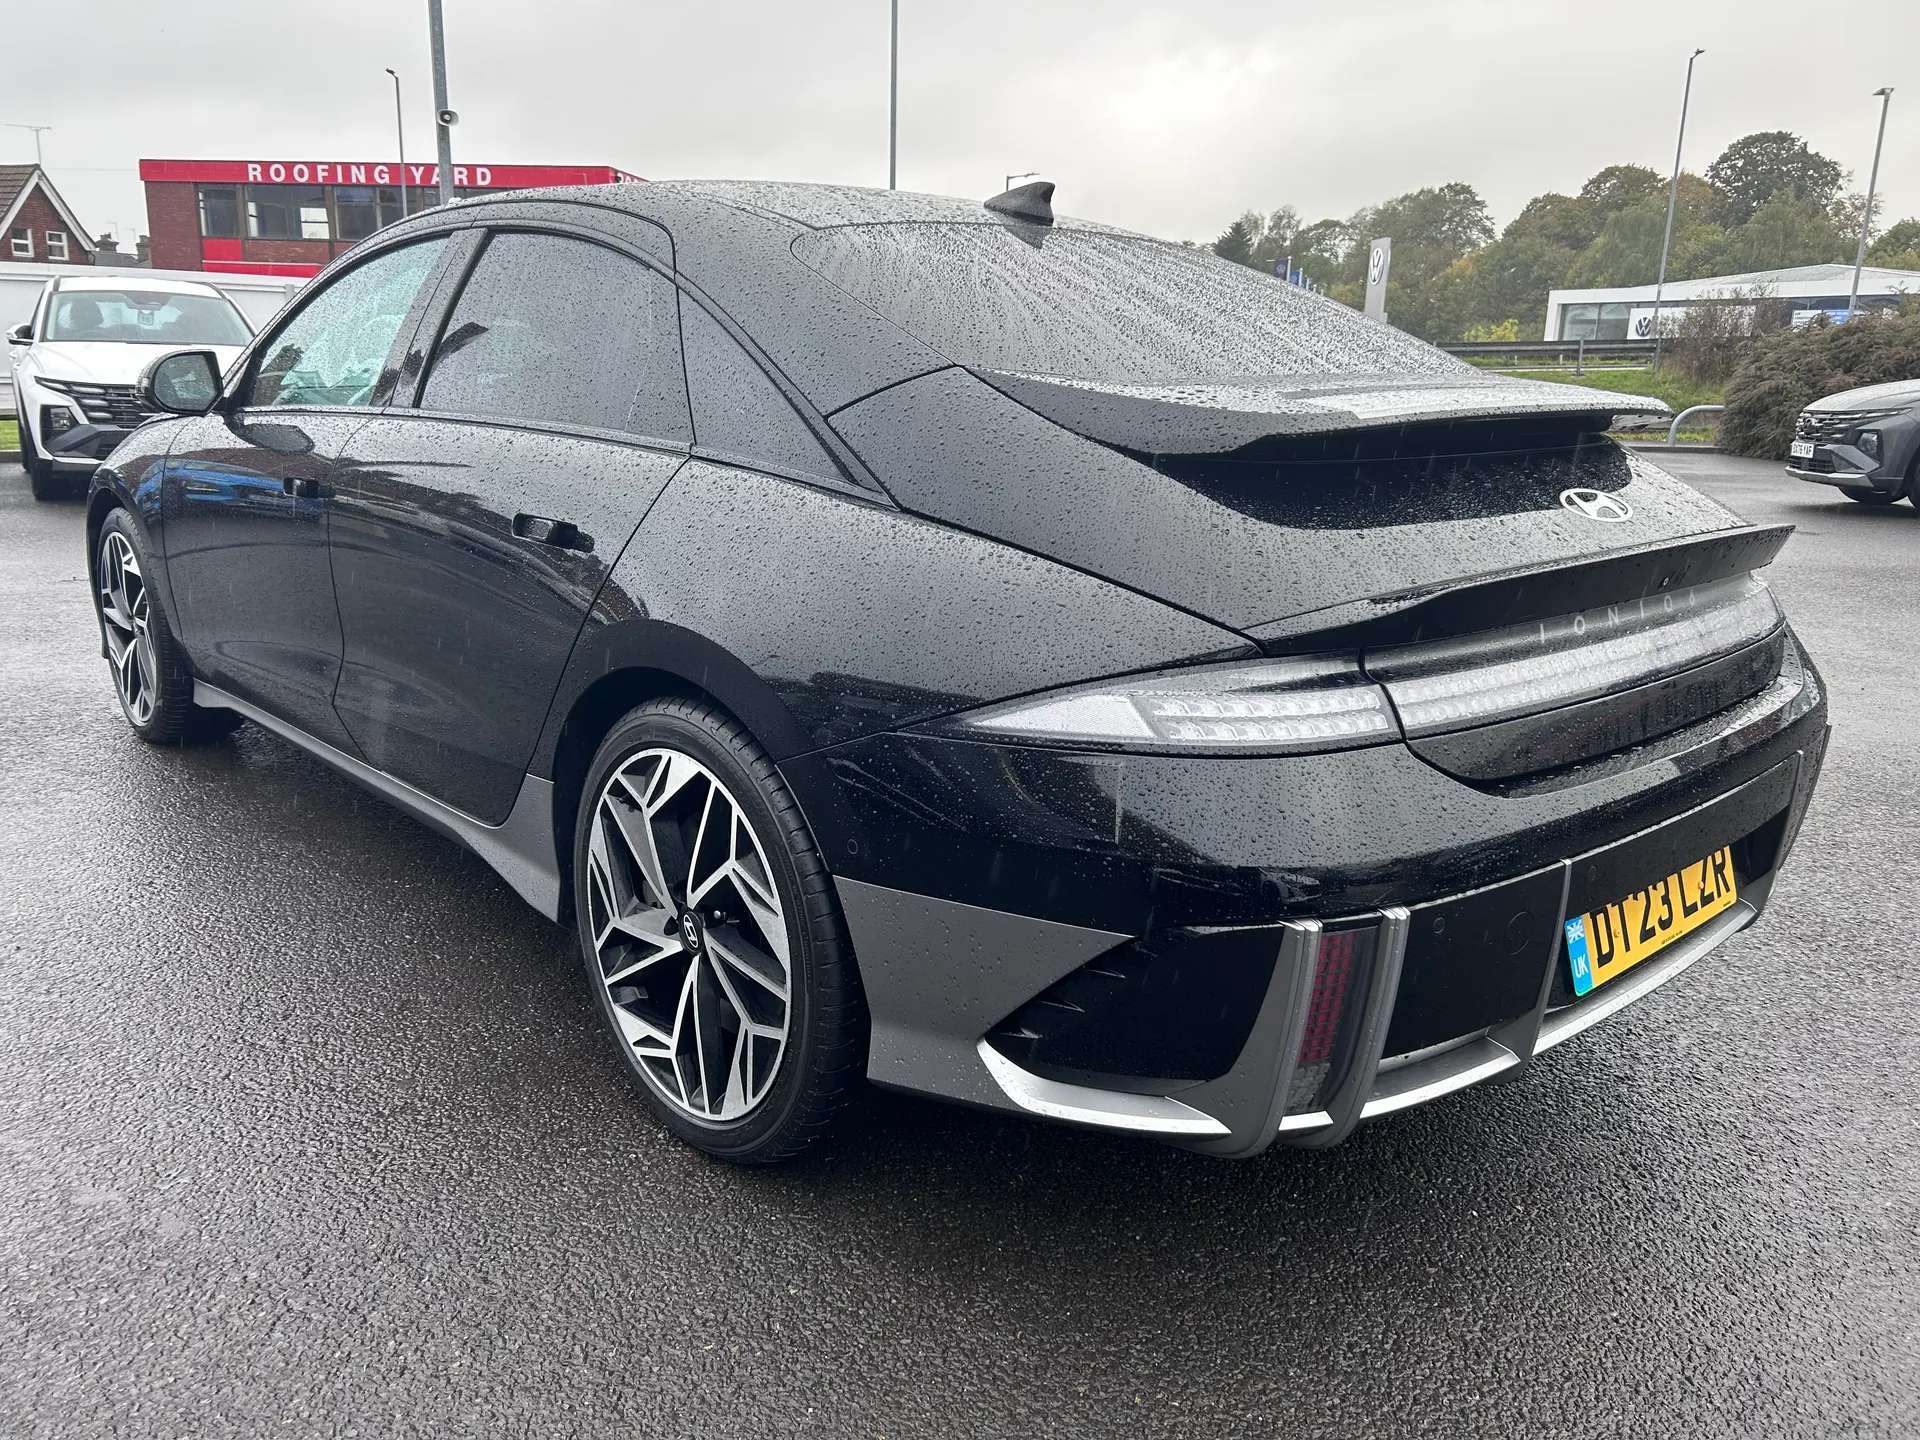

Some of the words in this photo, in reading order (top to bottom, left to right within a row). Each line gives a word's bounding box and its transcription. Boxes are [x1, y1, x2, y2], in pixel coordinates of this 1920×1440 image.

[247, 163, 389, 184] ROOFING
[1589, 874, 1673, 968] DT23
[1573, 953, 1589, 978] UK
